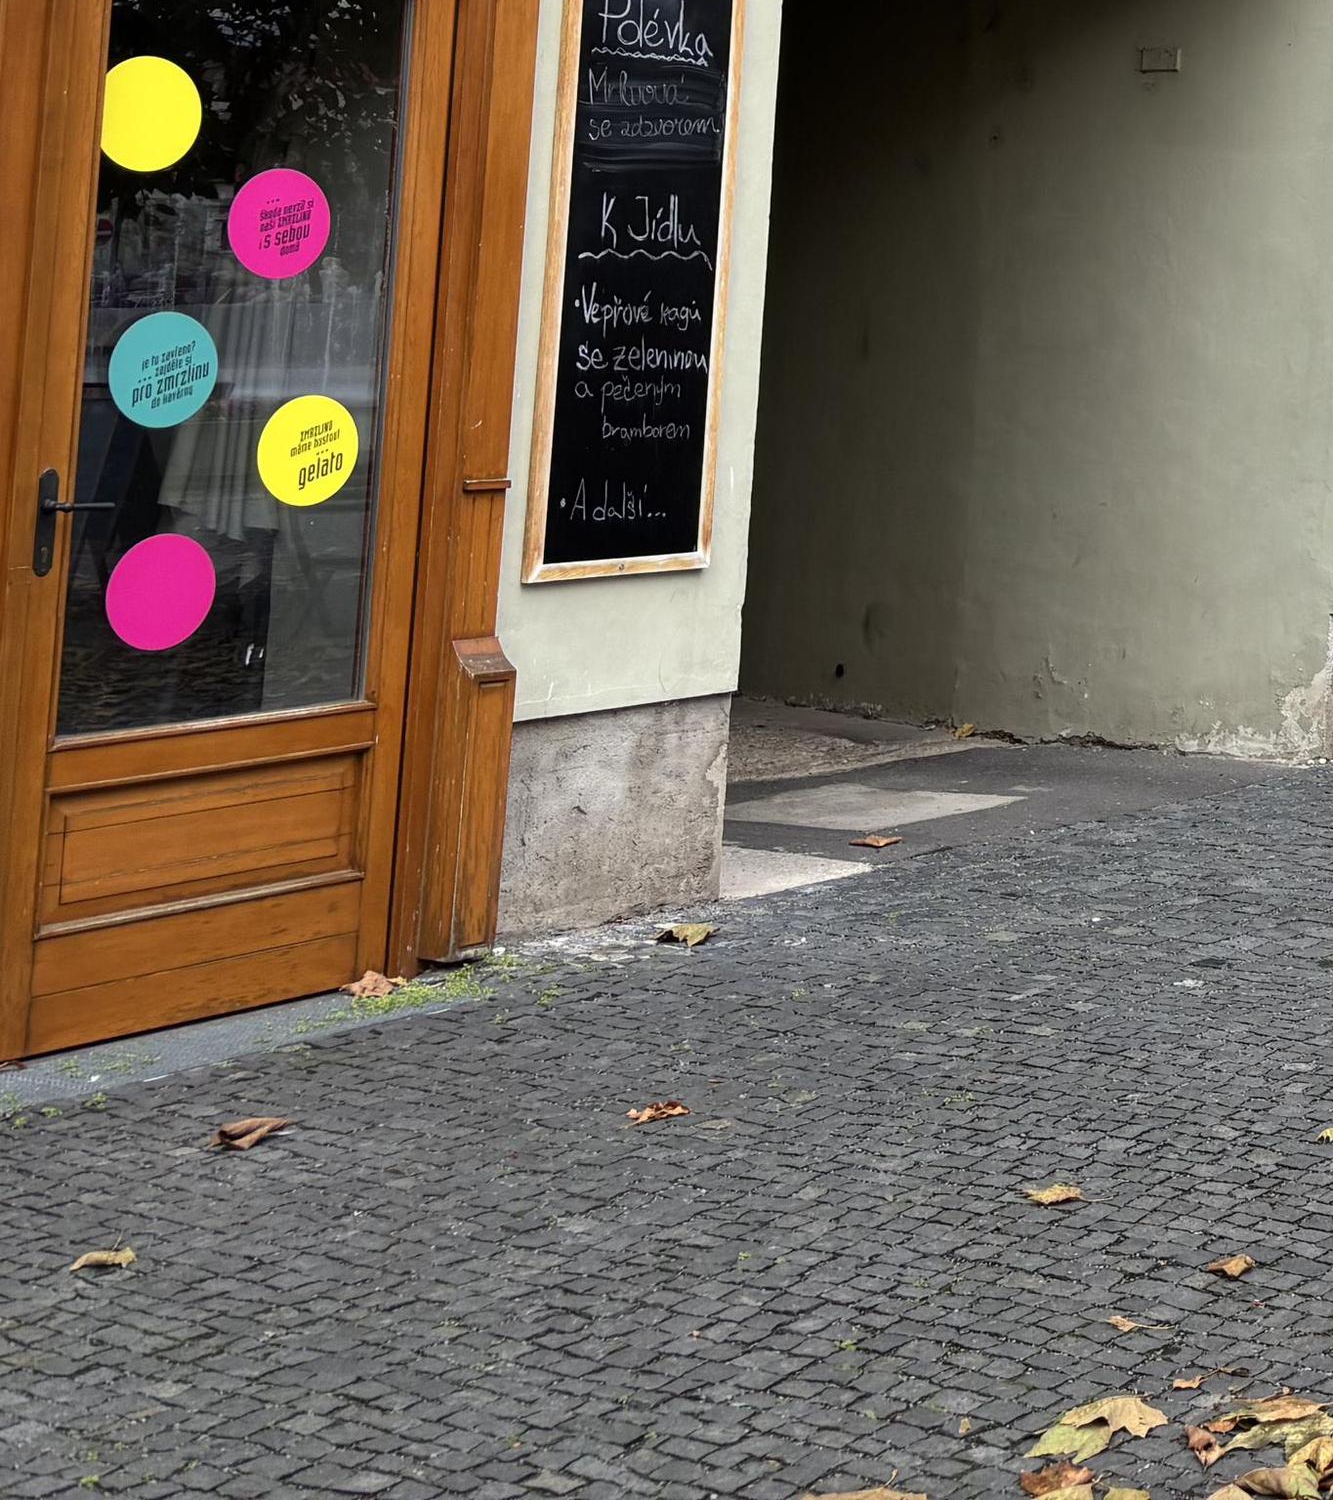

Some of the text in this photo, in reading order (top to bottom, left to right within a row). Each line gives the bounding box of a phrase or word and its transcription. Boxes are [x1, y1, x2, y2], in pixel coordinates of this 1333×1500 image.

[274, 223, 310, 246] sebou
[600, 191, 617, 249] K
[612, 334, 709, 374] zeleninou
[132, 362, 210, 407] pro zmrzlinu
[575, 375, 681, 415] a pečeným
[602, 413, 691, 440] bramborem
[298, 452, 343, 490] gelato
